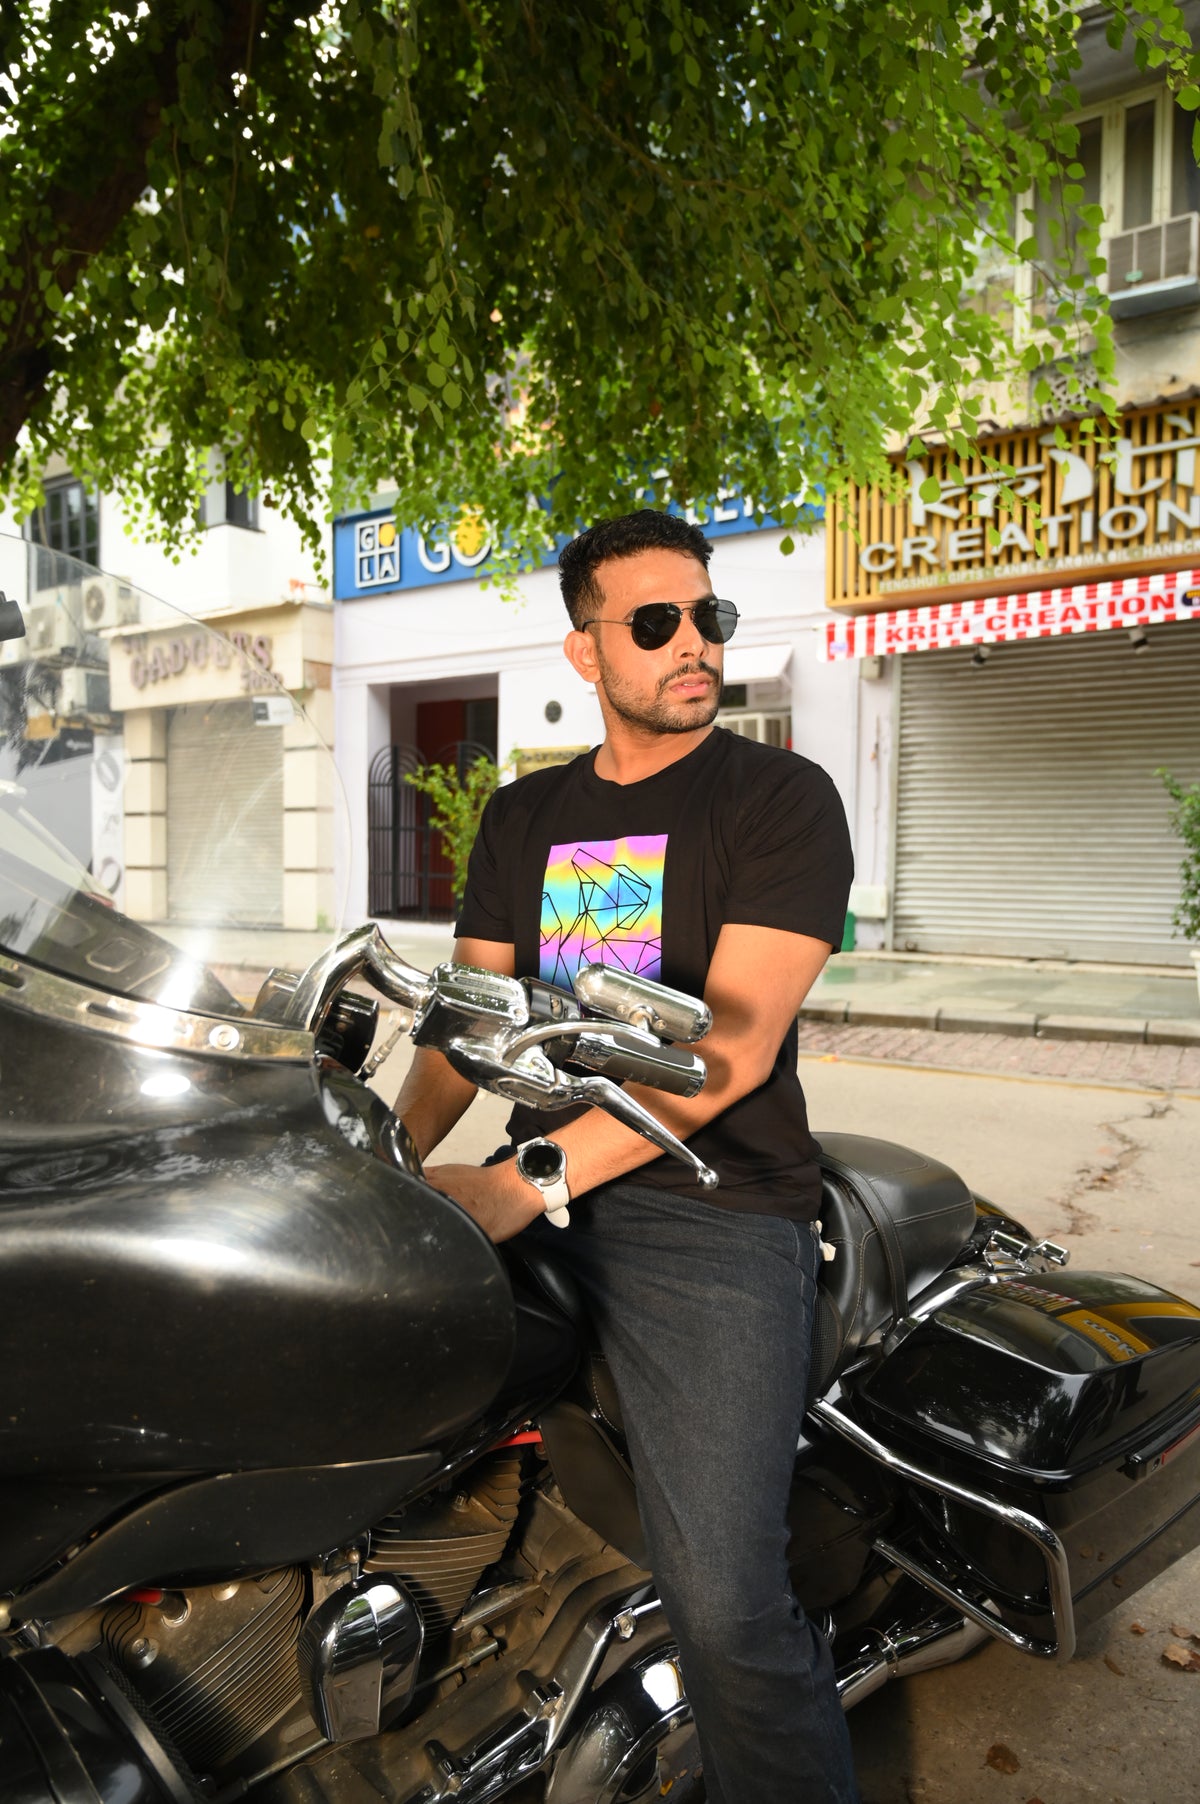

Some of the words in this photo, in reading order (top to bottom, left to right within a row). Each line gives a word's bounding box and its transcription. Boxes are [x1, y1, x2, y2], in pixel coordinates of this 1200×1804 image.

[859, 495, 1200, 573] CREATION
[878, 575, 939, 592] FENGSHUI
[947, 568, 985, 582] GIFTS
[991, 559, 1045, 578] CANDLE
[1056, 552, 1101, 569] AROMA
[1107, 548, 1130, 564] OIL
[886, 618, 971, 644] KRITI
[985, 593, 1175, 633] CREATION
